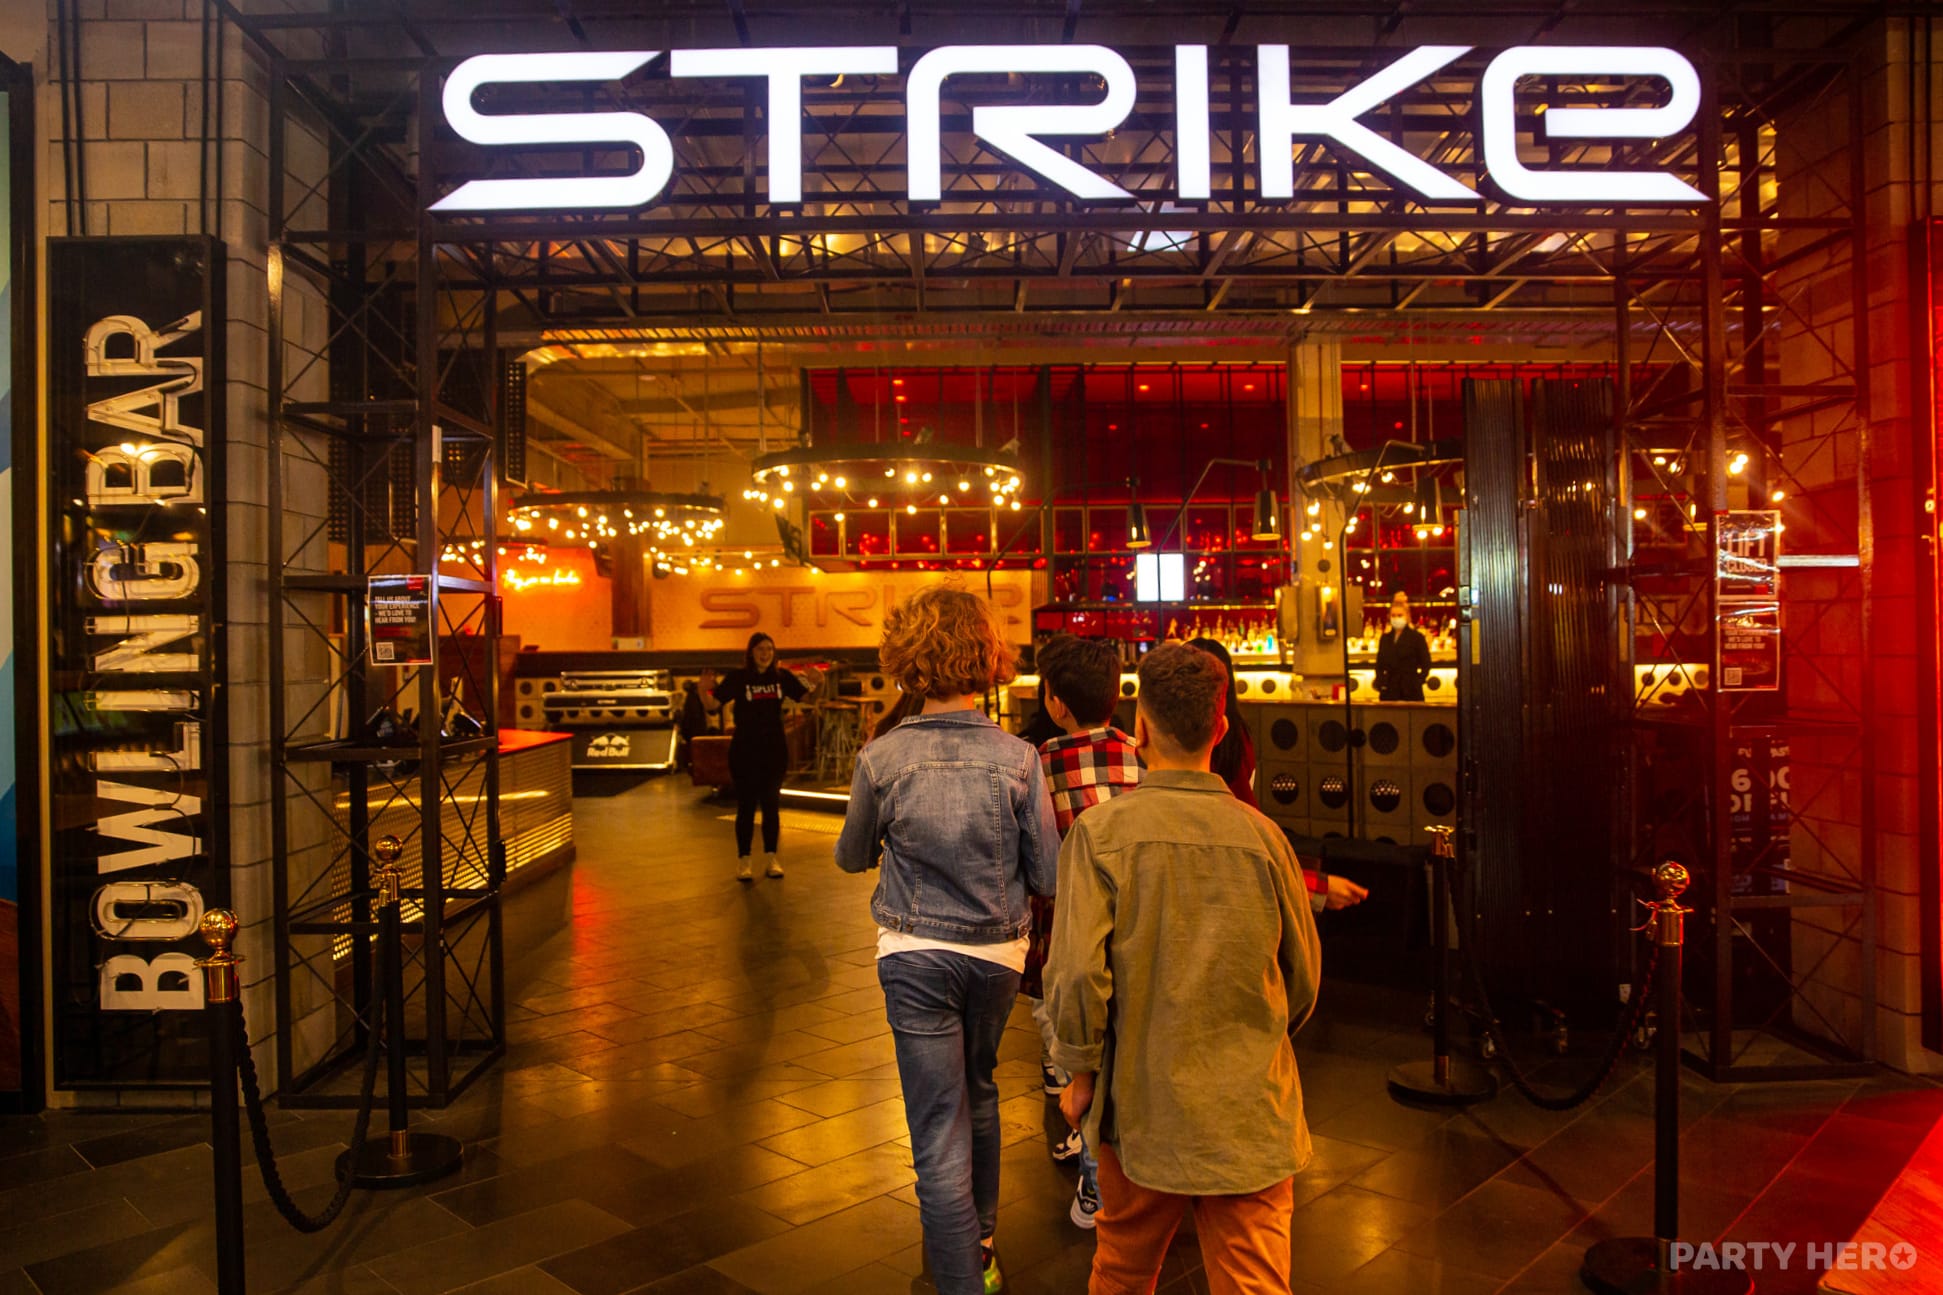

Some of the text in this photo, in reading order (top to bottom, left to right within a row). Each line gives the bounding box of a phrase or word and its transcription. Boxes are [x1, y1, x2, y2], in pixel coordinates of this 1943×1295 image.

[428, 44, 1711, 212] STRIKE
[1727, 530, 1766, 557] LIFT
[84, 310, 206, 1011] BOWLING BAR
[751, 684, 775, 694] SPLIT
[587, 746, 630, 758] Red Bull
